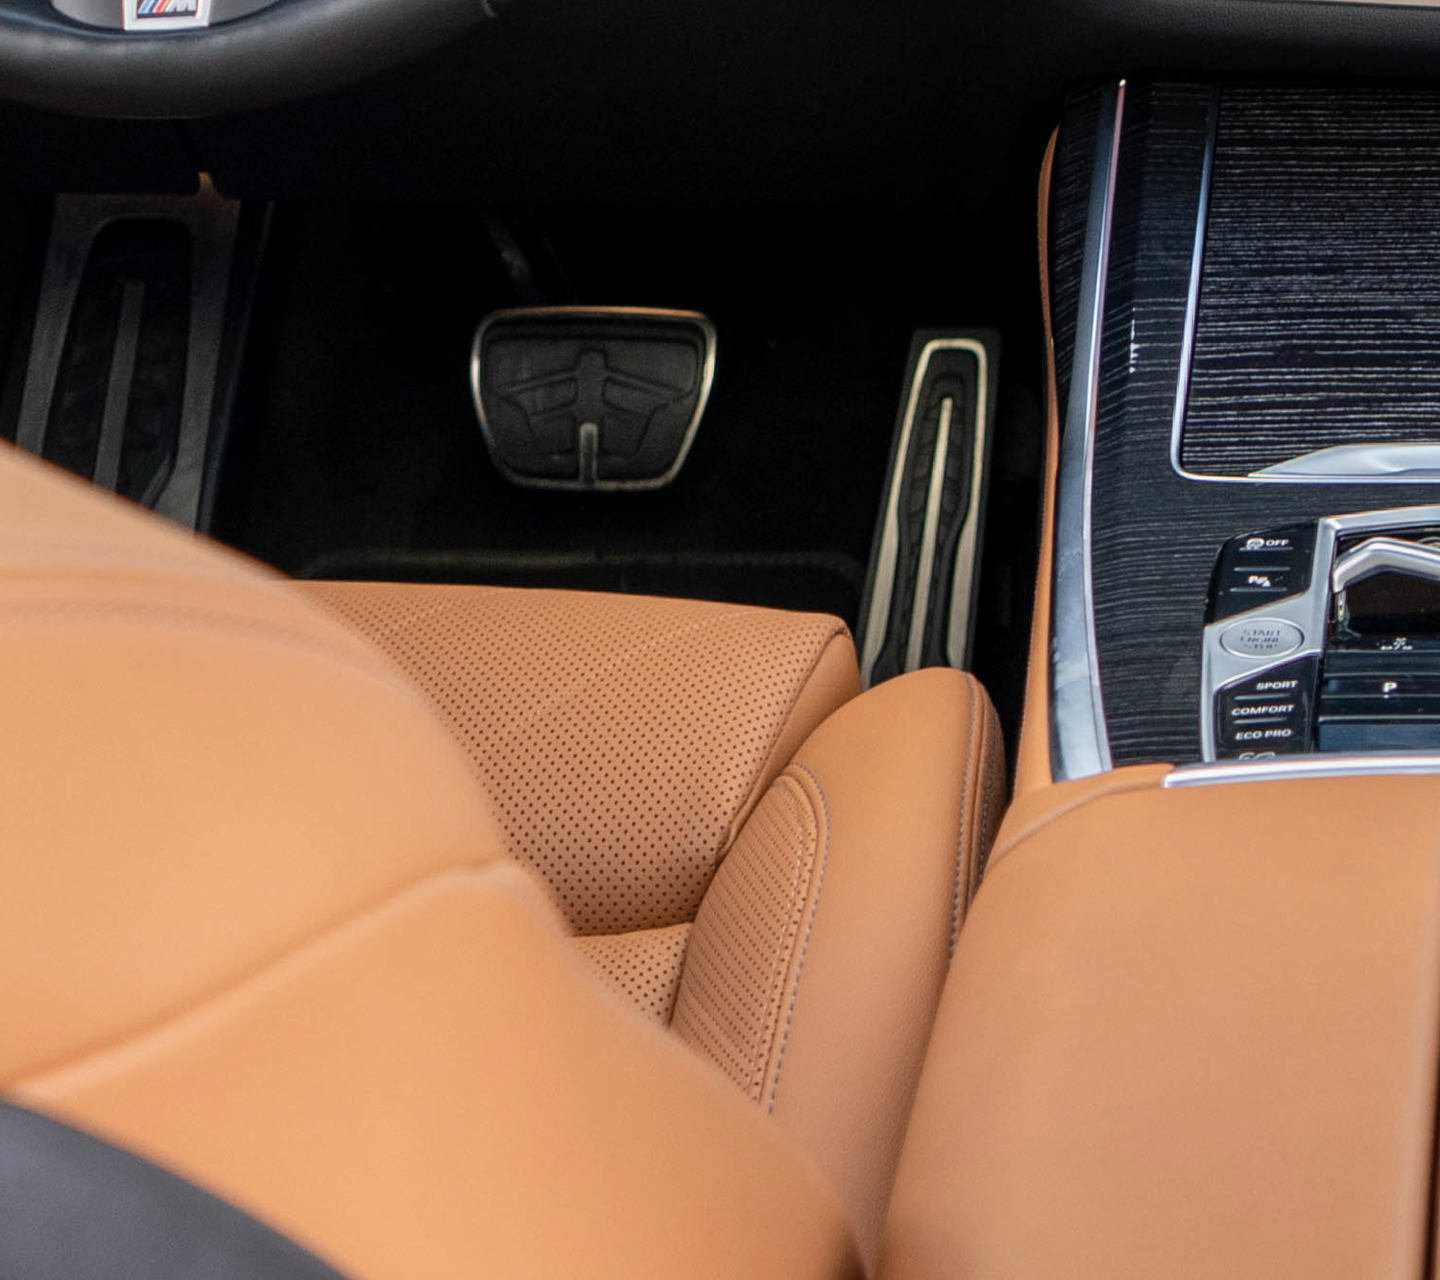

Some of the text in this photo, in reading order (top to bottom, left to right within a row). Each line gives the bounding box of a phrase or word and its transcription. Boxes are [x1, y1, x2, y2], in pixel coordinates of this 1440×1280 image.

[1256, 679, 1299, 691] SPORT
[1231, 703, 1295, 717] COMFORT
[1235, 728, 1292, 741] ECO PRO
